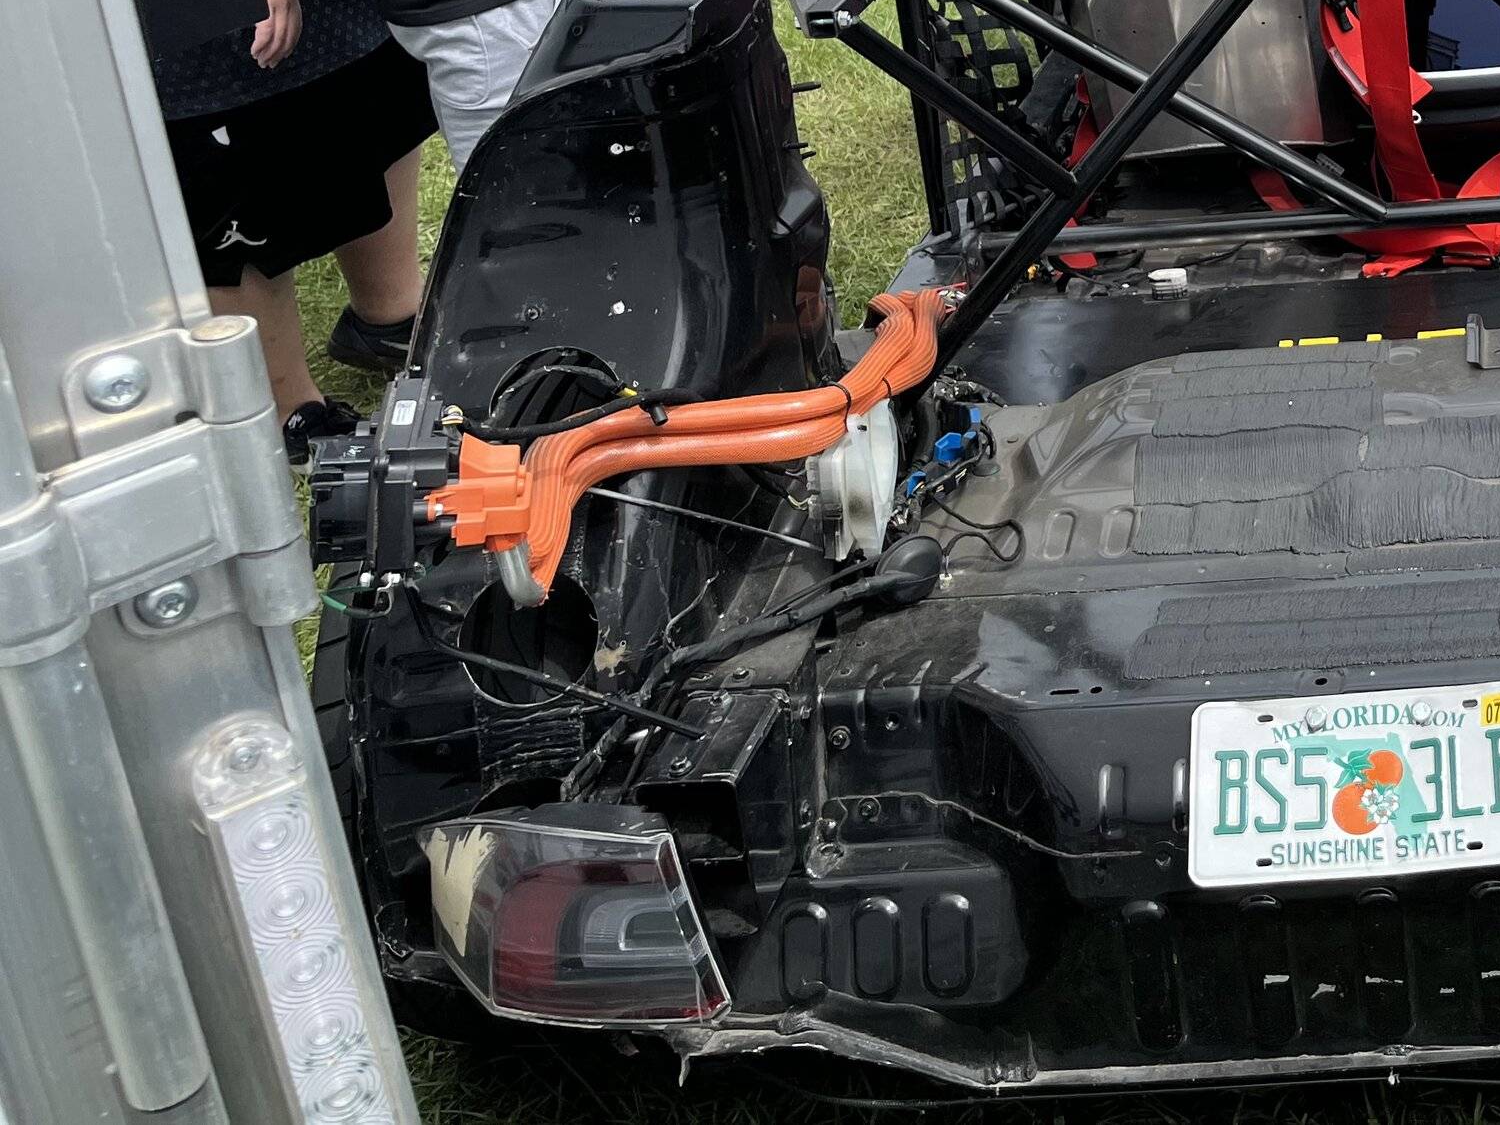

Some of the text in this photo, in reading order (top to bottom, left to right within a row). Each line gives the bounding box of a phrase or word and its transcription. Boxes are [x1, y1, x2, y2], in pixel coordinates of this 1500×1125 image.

[1213, 746, 1328, 836] BS5
[1271, 829, 1466, 868] SUNSHINE STATE
